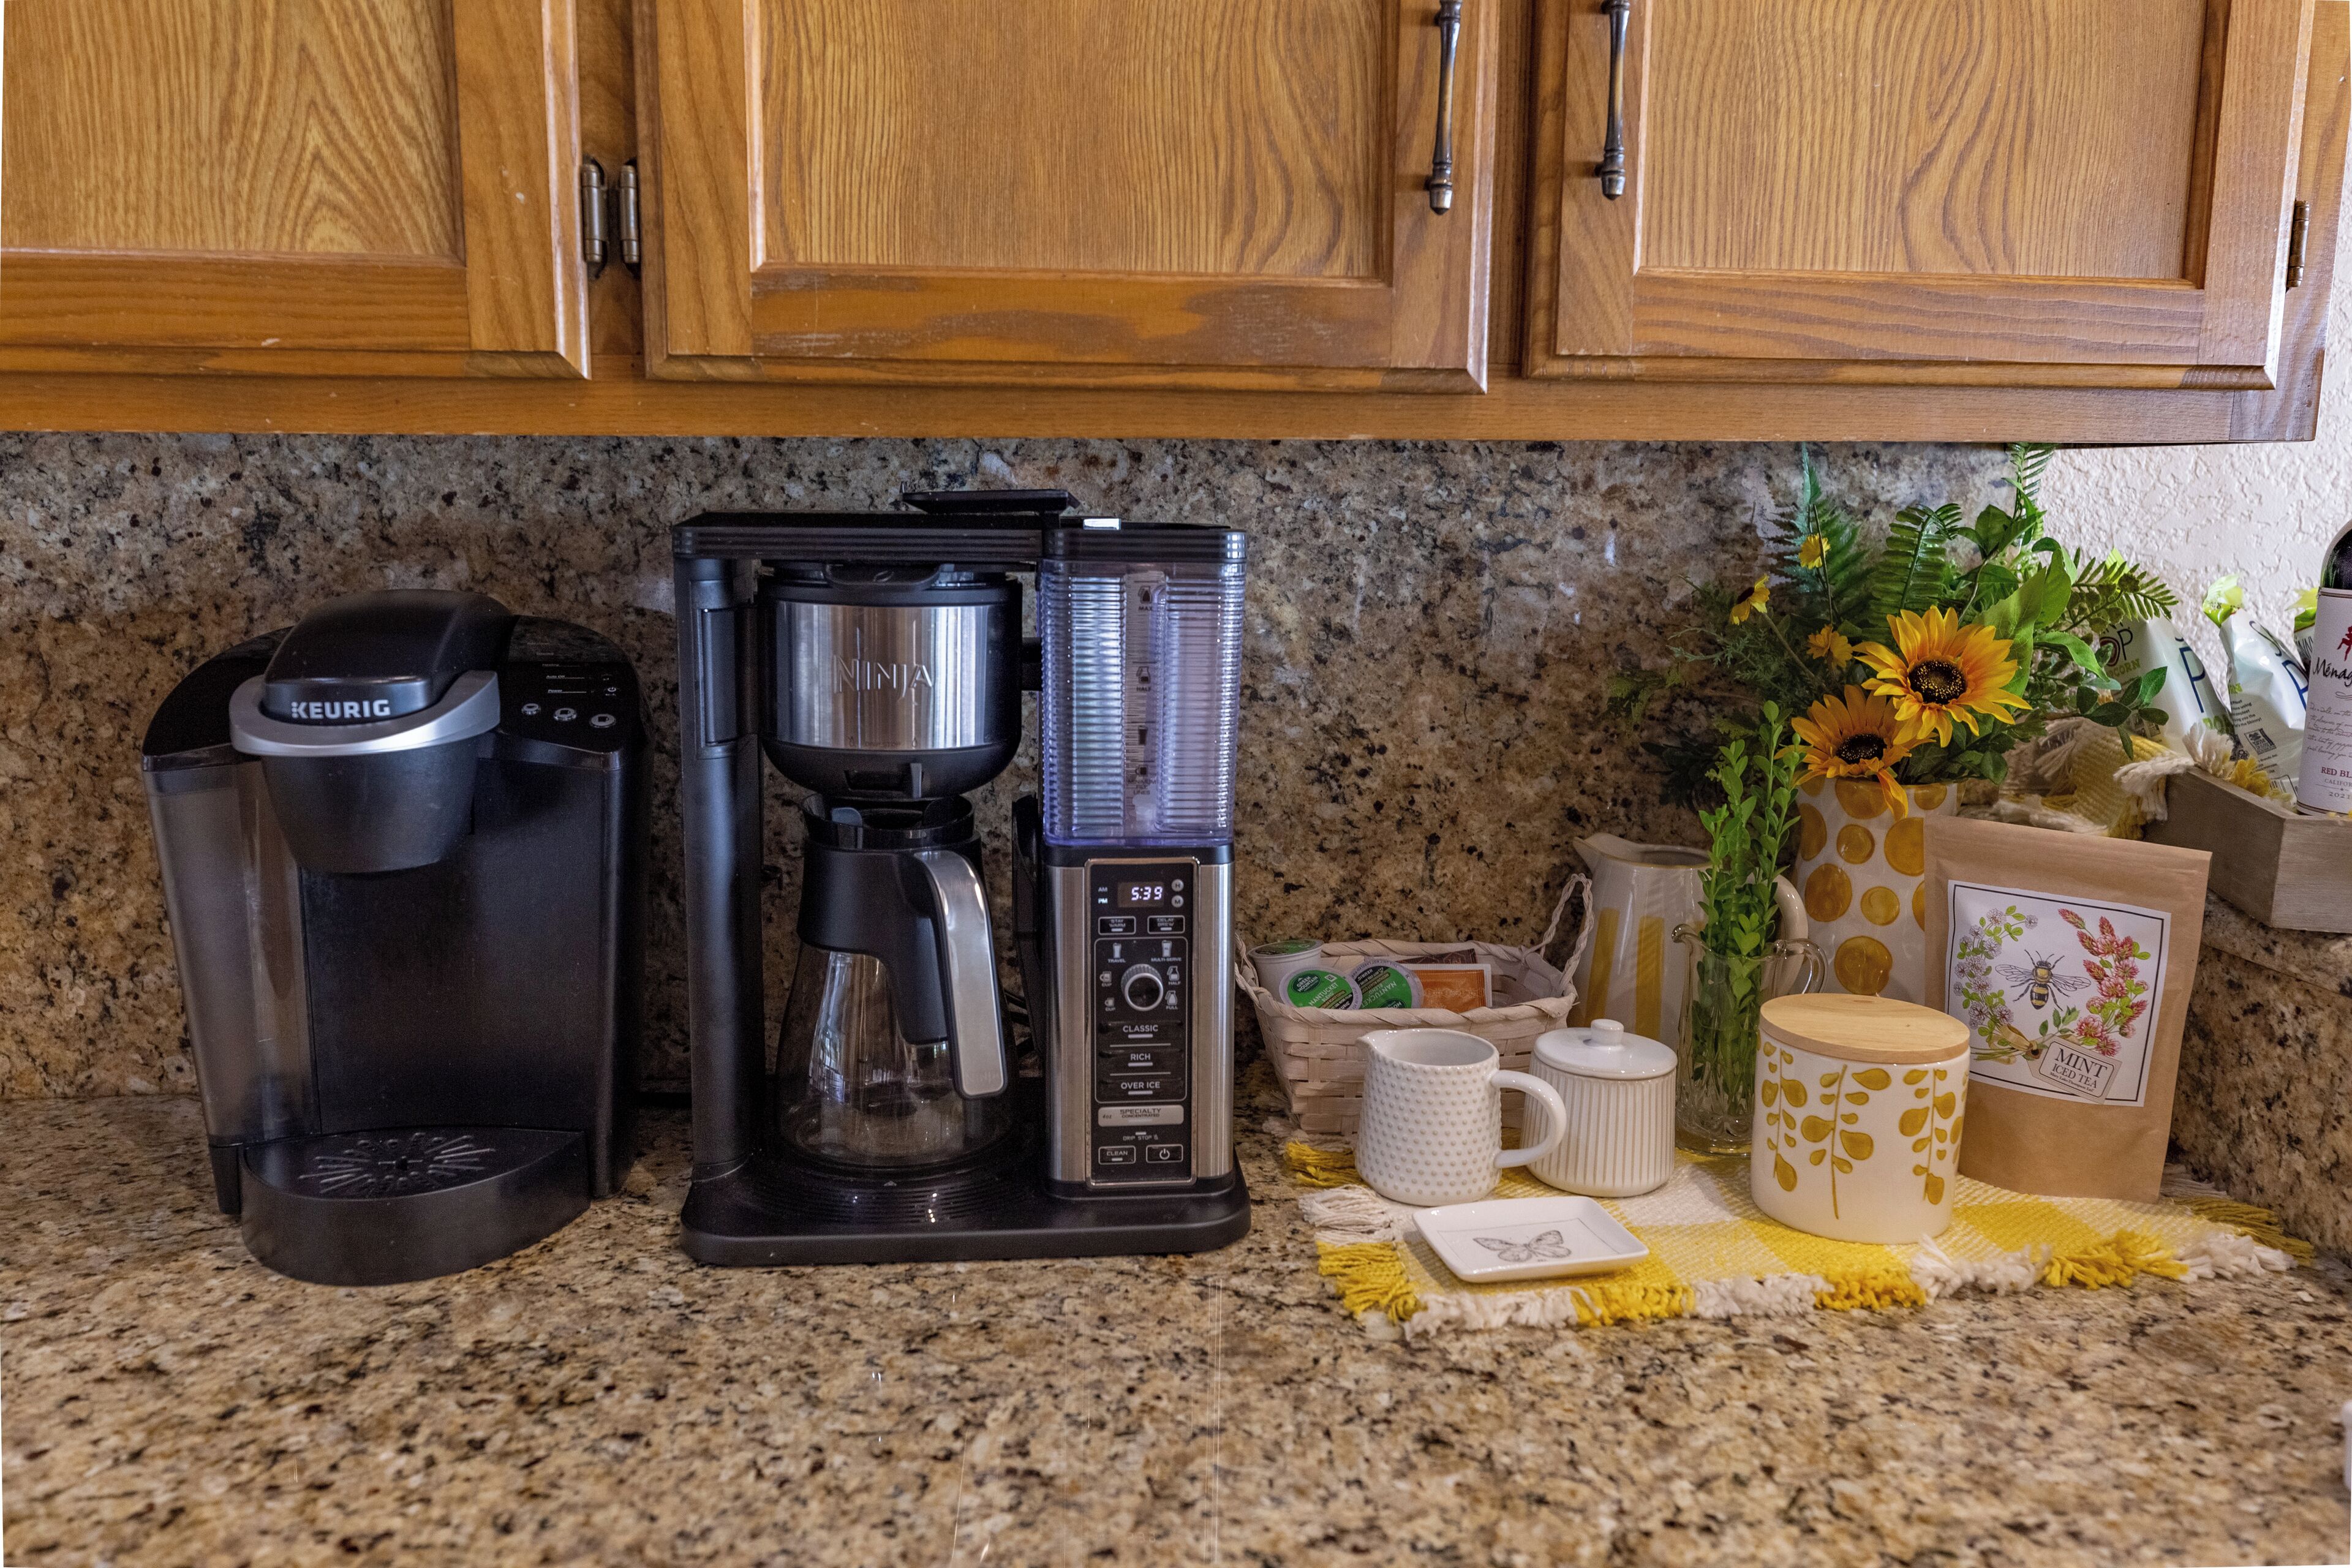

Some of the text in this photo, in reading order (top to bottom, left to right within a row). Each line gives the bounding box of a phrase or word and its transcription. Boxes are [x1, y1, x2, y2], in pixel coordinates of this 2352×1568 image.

[834, 655, 932, 703] NINJA
[291, 699, 391, 719] KEURIG
[2321, 767, 2337, 775] RED
[1131, 886, 1163, 900] 5:39
[1297, 976, 1311, 987] GREEN
[1298, 976, 1318, 992] MOUNTAIN
[1308, 982, 1339, 1006] NANTUCKET
[1321, 992, 1334, 1002] BLEND
[1360, 981, 1397, 1008] NANTUCKET
[2054, 1047, 2108, 1078] MINT
[2052, 1063, 2097, 1088] ICED TEA
